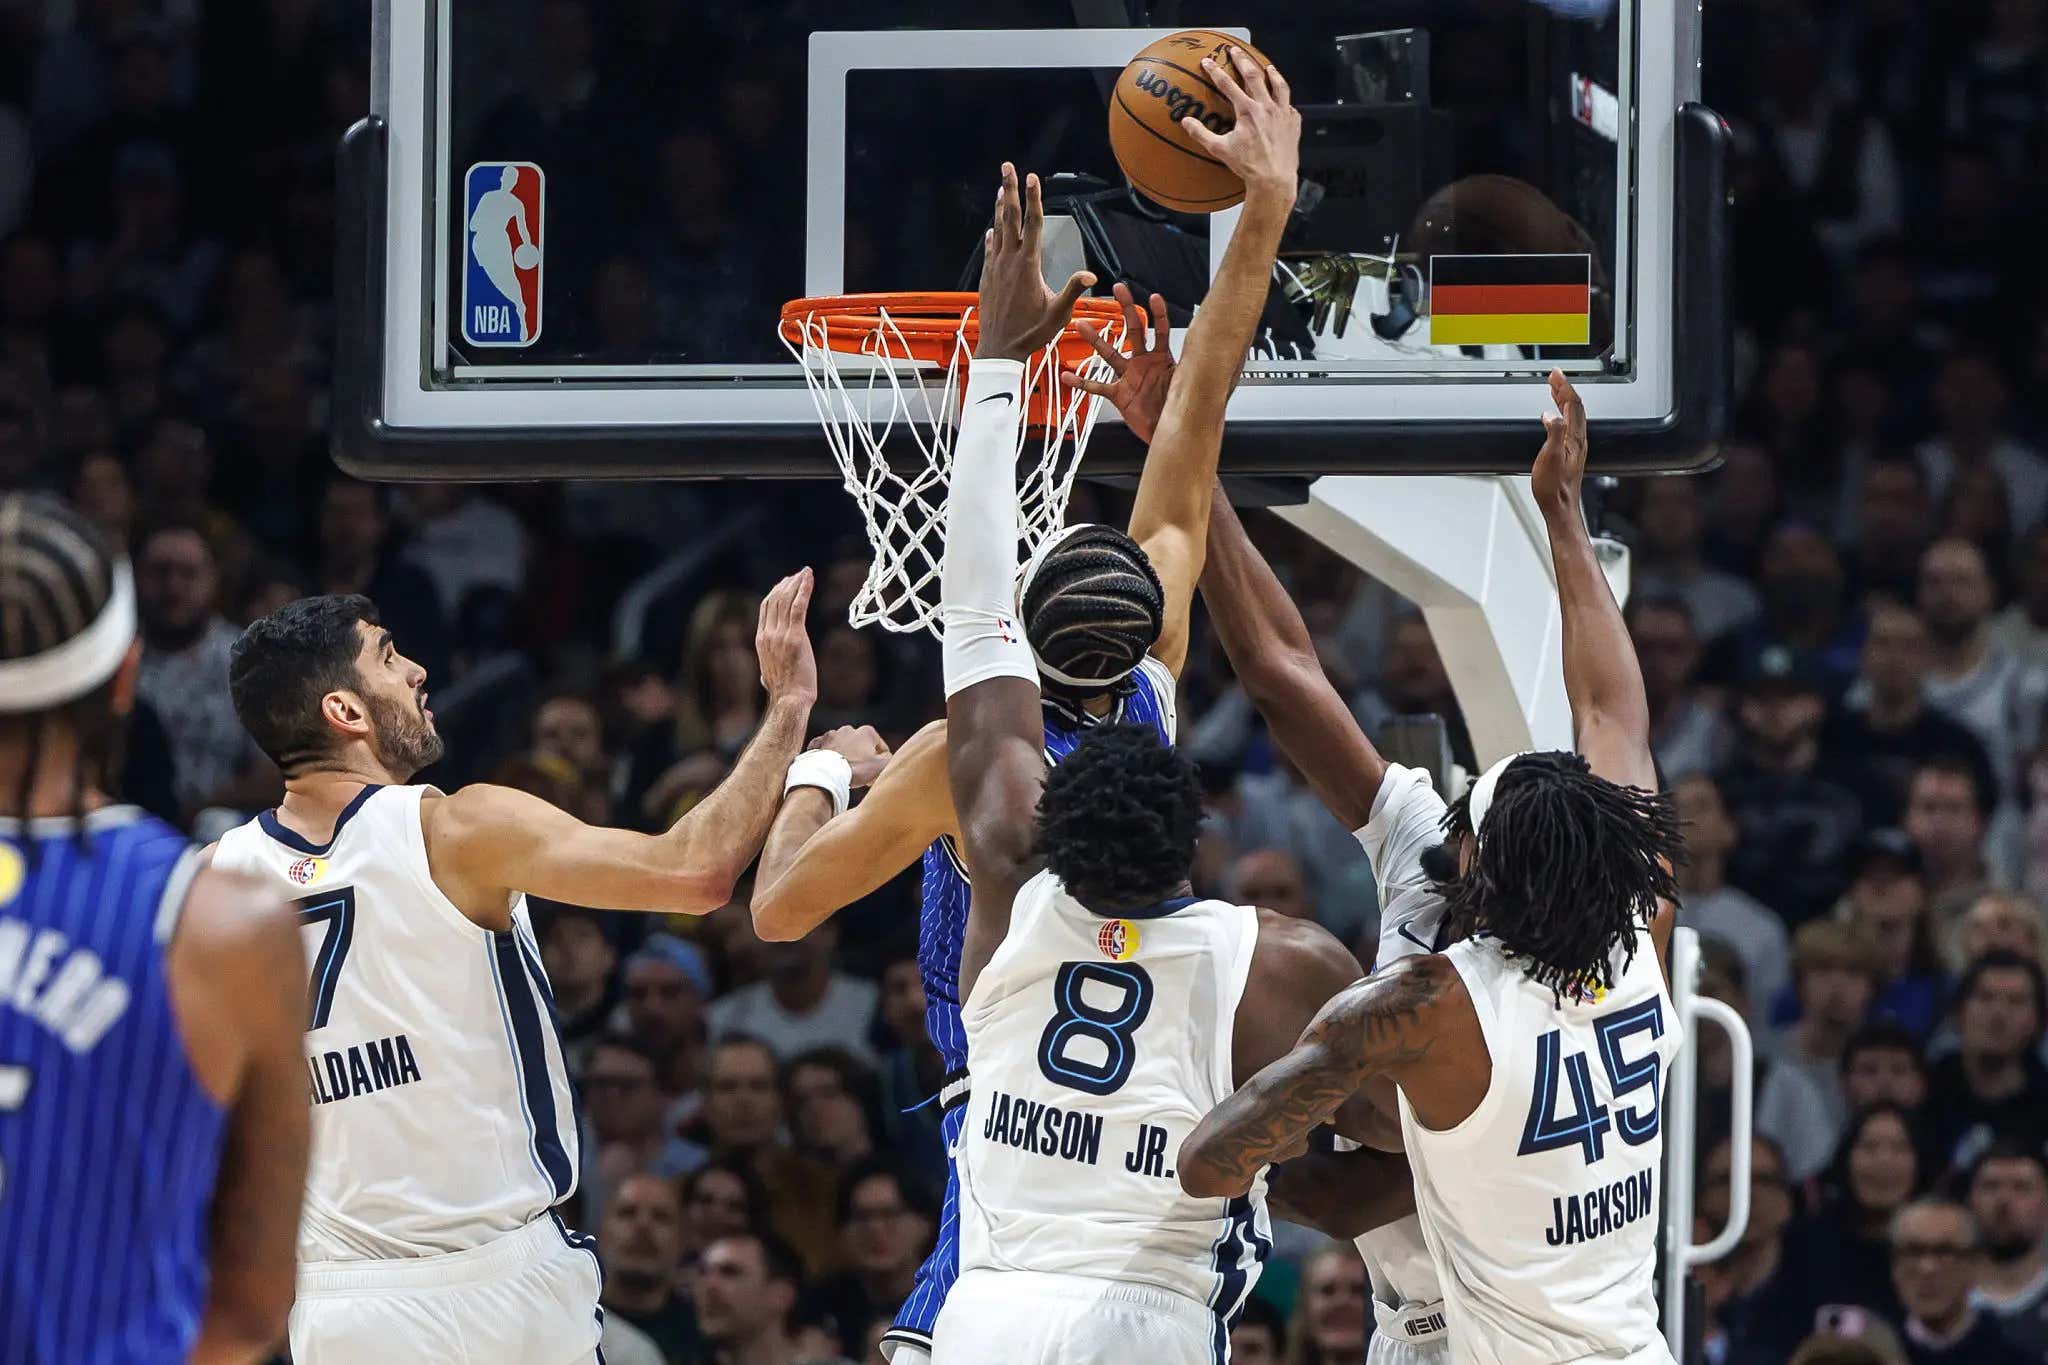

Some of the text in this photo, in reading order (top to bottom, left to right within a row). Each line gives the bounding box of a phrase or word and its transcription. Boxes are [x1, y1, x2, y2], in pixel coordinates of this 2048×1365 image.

[474, 305, 511, 334] NBA
[286, 885, 355, 1032] 7
[1037, 961, 1154, 1096] 8
[1517, 994, 1664, 1166] 45
[984, 1091, 1175, 1179] JACKSON JR.
[1545, 1167, 1652, 1246] JACKSON
